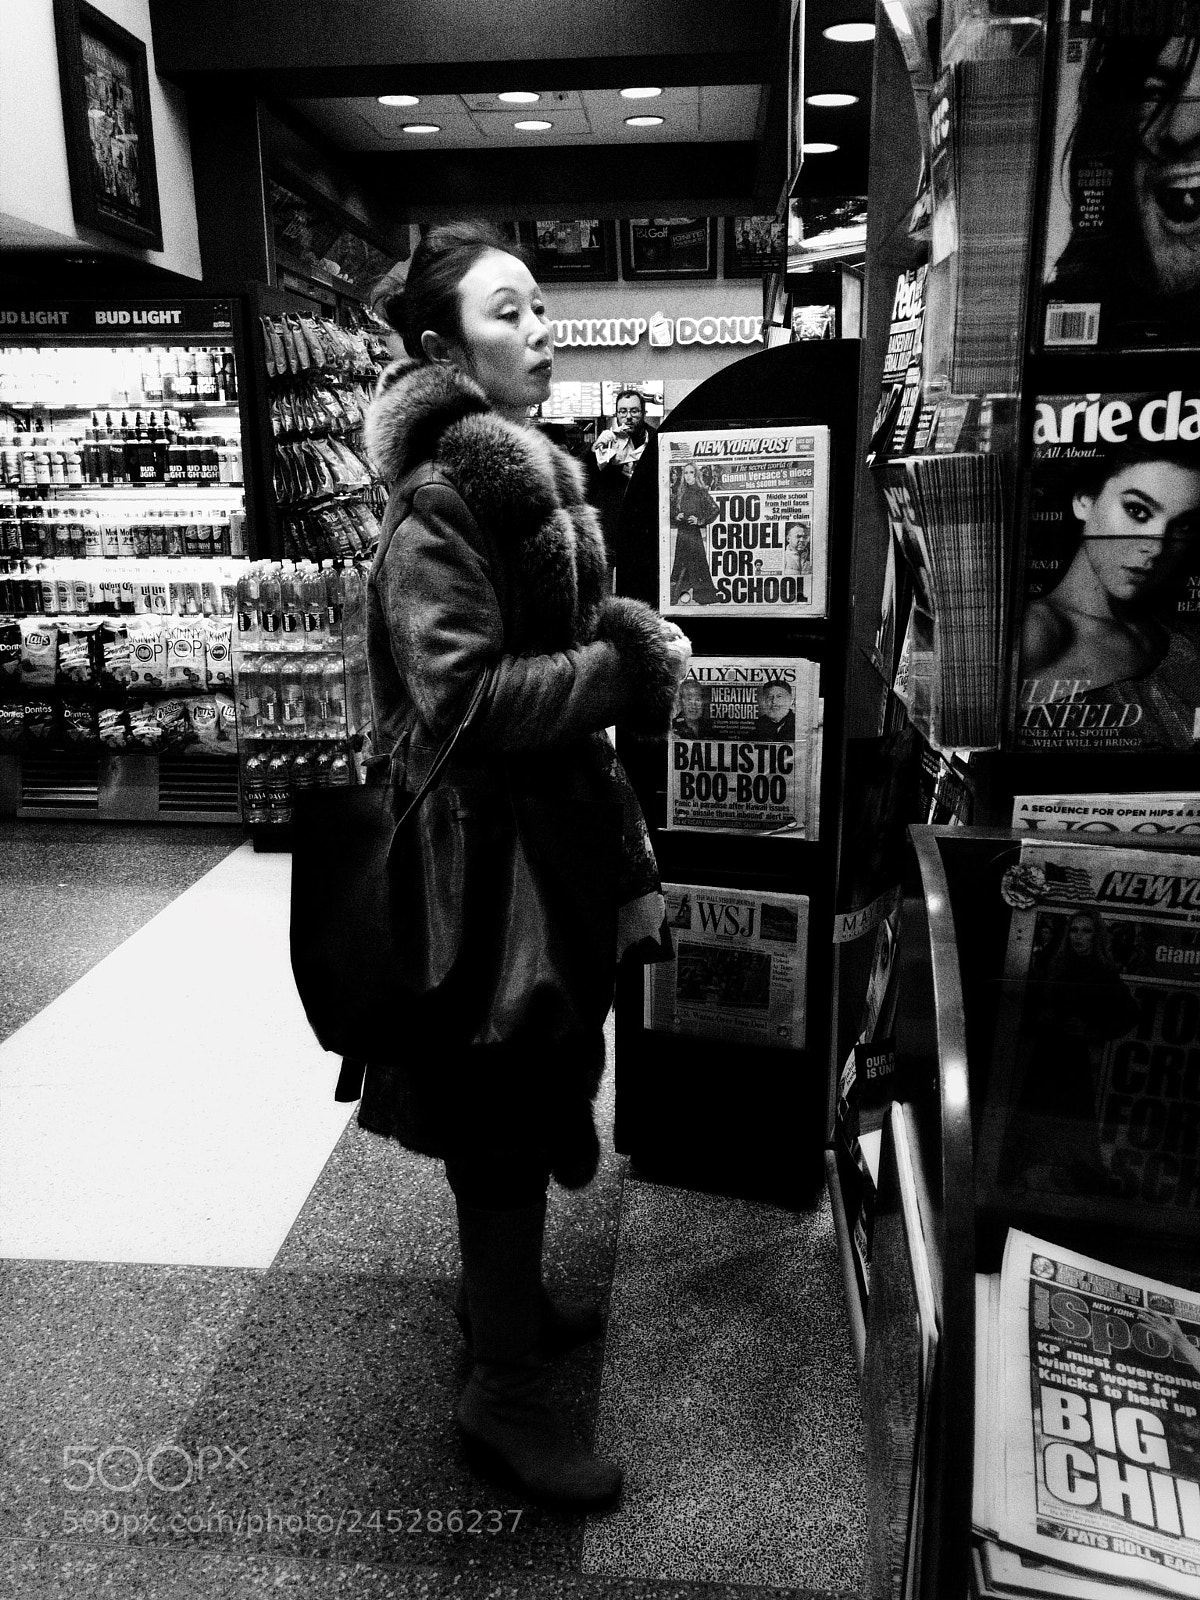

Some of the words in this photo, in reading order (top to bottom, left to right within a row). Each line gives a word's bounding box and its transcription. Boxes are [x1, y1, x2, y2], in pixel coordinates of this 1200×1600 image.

[21, 311, 69, 324] LIGHT
[95, 311, 130, 324] BUD
[132, 311, 181, 324] LIGHT
[1033, 394, 1132, 444] arie
[1138, 390, 1200, 441] cla
[694, 440, 726, 456] NEW
[723, 438, 760, 455] YORK
[758, 437, 794, 454] POST
[1042, 447, 1060, 458] All
[1061, 447, 1105, 458] About...
[768, 462, 786, 470] world
[722, 473, 747, 483] Gianni
[748, 470, 787, 481] Versace's
[789, 468, 812, 477] niece
[716, 495, 760, 522] TOO
[712, 522, 783, 550] CRUEL
[711, 551, 753, 577] FOR
[152, 586, 166, 595] Lite
[717, 577, 808, 604] SCHOOL
[128, 631, 162, 643] SKINNY
[169, 628, 201, 639] SKINNY
[129, 643, 163, 662] POP
[168, 640, 202, 657] POP
[685, 667, 730, 682] AILY
[734, 667, 796, 682] NEWS
[711, 687, 758, 703] NEGATIVE
[25, 706, 52, 714] Doritos
[64, 709, 91, 718] Doritos
[710, 703, 758, 720] EXPOSURE
[1022, 703, 1142, 728] INFELD
[1051, 729, 1065, 738] AT
[1080, 729, 1120, 738] SPOTIFY
[1066, 738, 1092, 747] WILL
[1105, 738, 1142, 748] BRING?
[674, 742, 794, 774] BALLISTIC
[680, 772, 787, 804] BOO-BOO
[691, 808, 715, 816] 'missile
[737, 811, 765, 819] inbound'
[746, 803, 768, 811] Hawaii
[1032, 805, 1089, 815] SEQUENCE
[1092, 806, 1114, 815] FOR
[1117, 807, 1147, 816] OPEN
[1150, 808, 1174, 817] HIPS
[1185, 809, 1194, 817] A
[1105, 871, 1172, 900] NEW
[697, 902, 757, 938] WSJ
[866, 1055, 886, 1068] OUR
[866, 1067, 877, 1079] IS
[1092, 1302, 1112, 1312] NEW
[1113, 1307, 1135, 1319] YORK
[1038, 1341, 1060, 1354] KP
[1066, 1351, 1111, 1369] must
[1115, 1362, 1200, 1390] overcome
[1038, 1356, 1095, 1378] winter
[1100, 1372, 1148, 1391] woes
[1152, 1382, 1180, 1398] for
[1039, 1367, 1099, 1393] Knicks
[1103, 1384, 1123, 1399] to
[1127, 1390, 1169, 1410] heat
[1173, 1402, 1198, 1418] up
[1041, 1386, 1171, 1470] BIG
[1067, 1527, 1109, 1549] PATS
[1112, 1536, 1160, 1564] ROLL,
